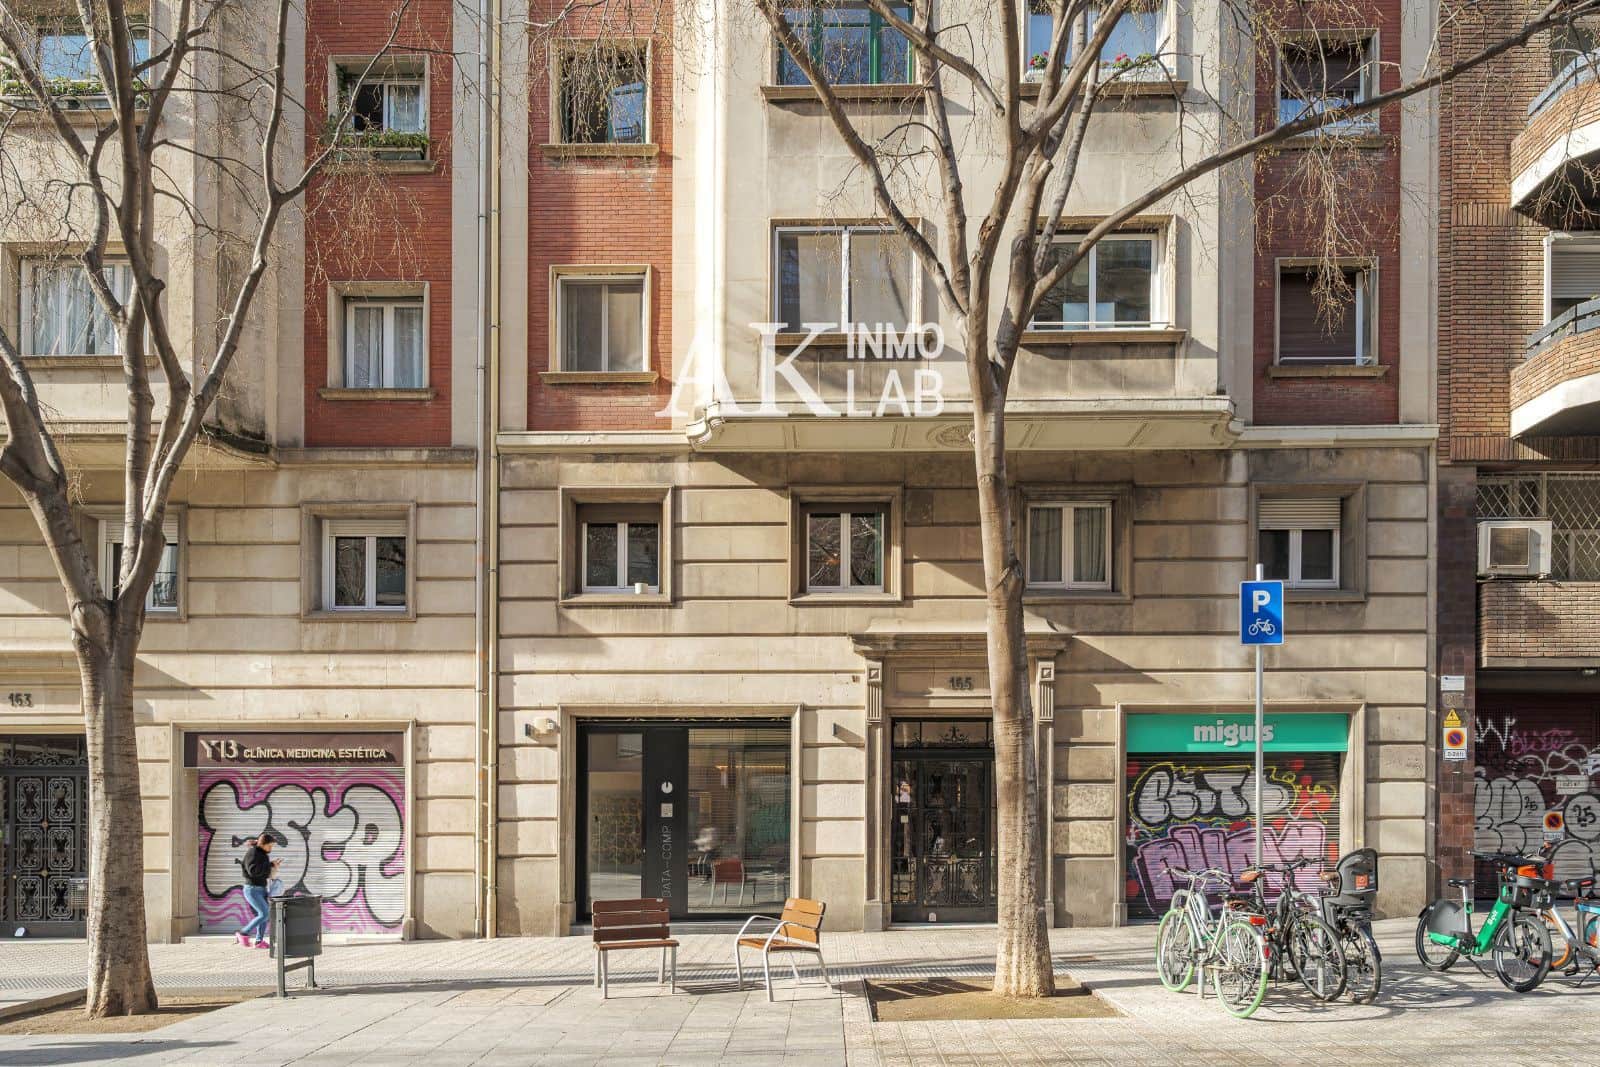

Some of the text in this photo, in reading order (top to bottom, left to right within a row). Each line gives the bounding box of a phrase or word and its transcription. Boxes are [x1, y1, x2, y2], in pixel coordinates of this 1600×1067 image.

[1252, 590, 1271, 613] P
[949, 676, 972, 691] 155
[8, 692, 33, 708] 153
[1194, 719, 1274, 746] migus
[243, 747, 285, 759] CLÍNICA
[286, 748, 336, 759] MEDICINA
[338, 746, 387, 759] ESTÉTICA
[1573, 804, 1597, 824] 25
